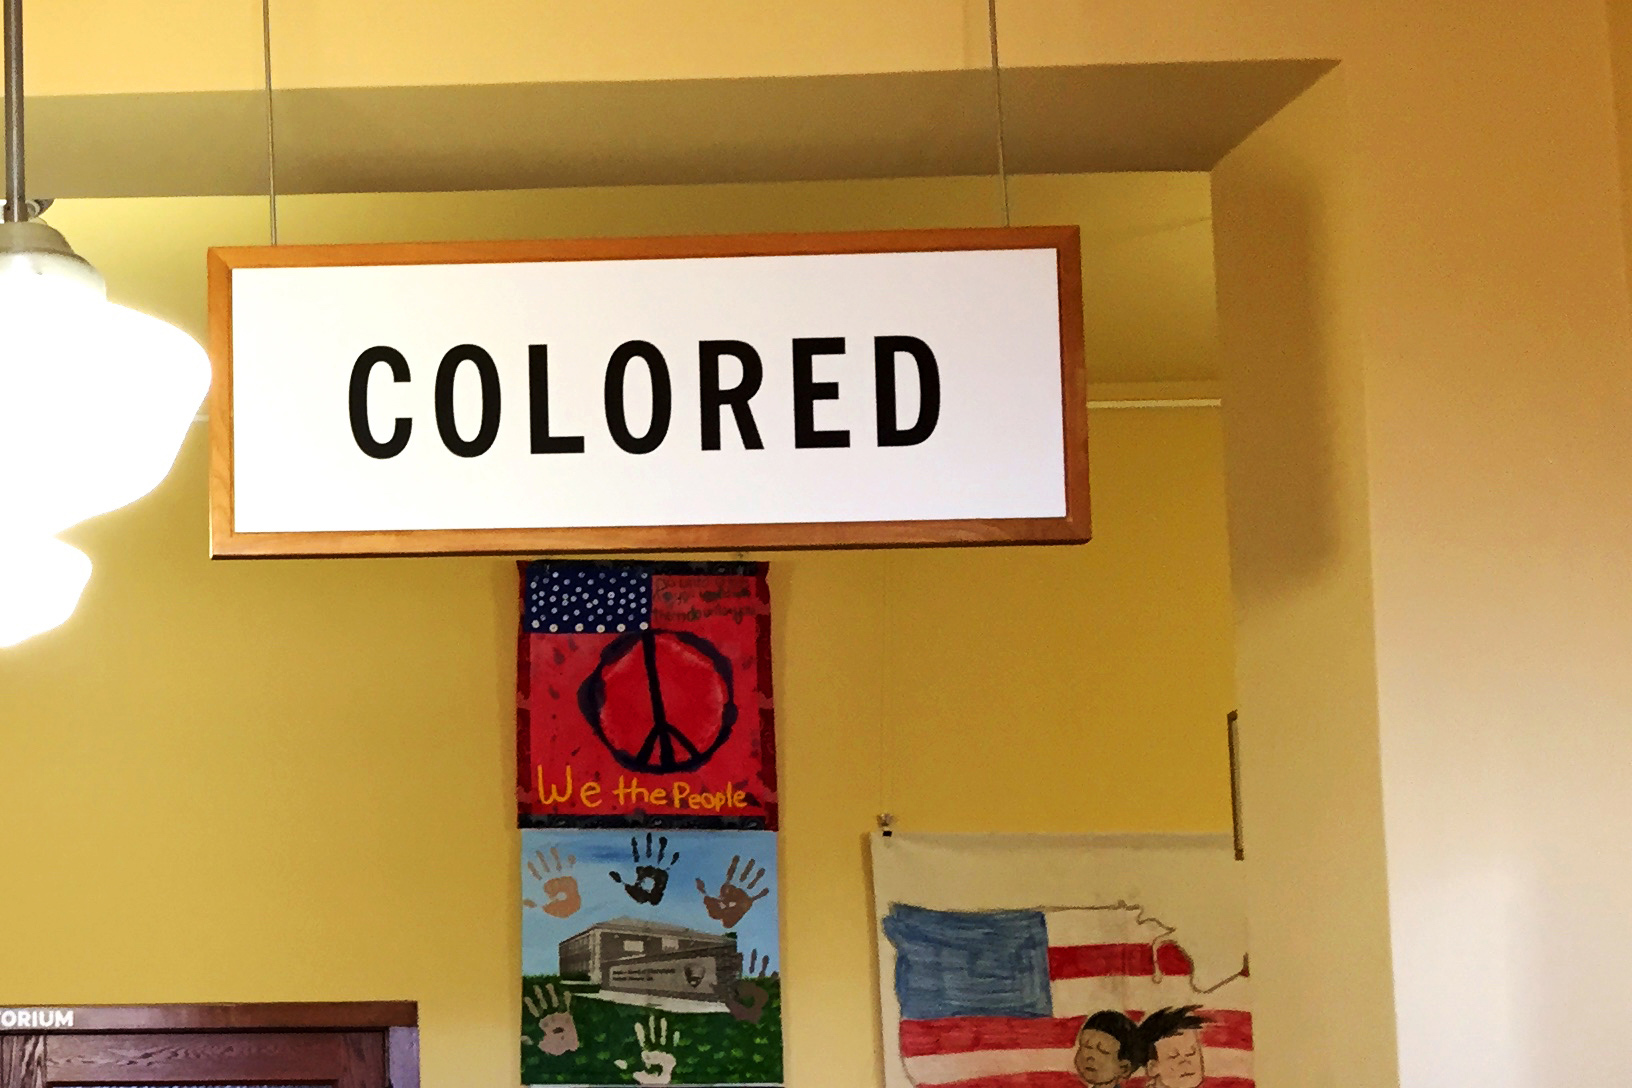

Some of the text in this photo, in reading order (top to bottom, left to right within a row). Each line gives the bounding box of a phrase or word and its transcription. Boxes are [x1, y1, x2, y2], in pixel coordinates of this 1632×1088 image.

[348, 335, 942, 460] COLORED
[537, 764, 749, 812] We the People
